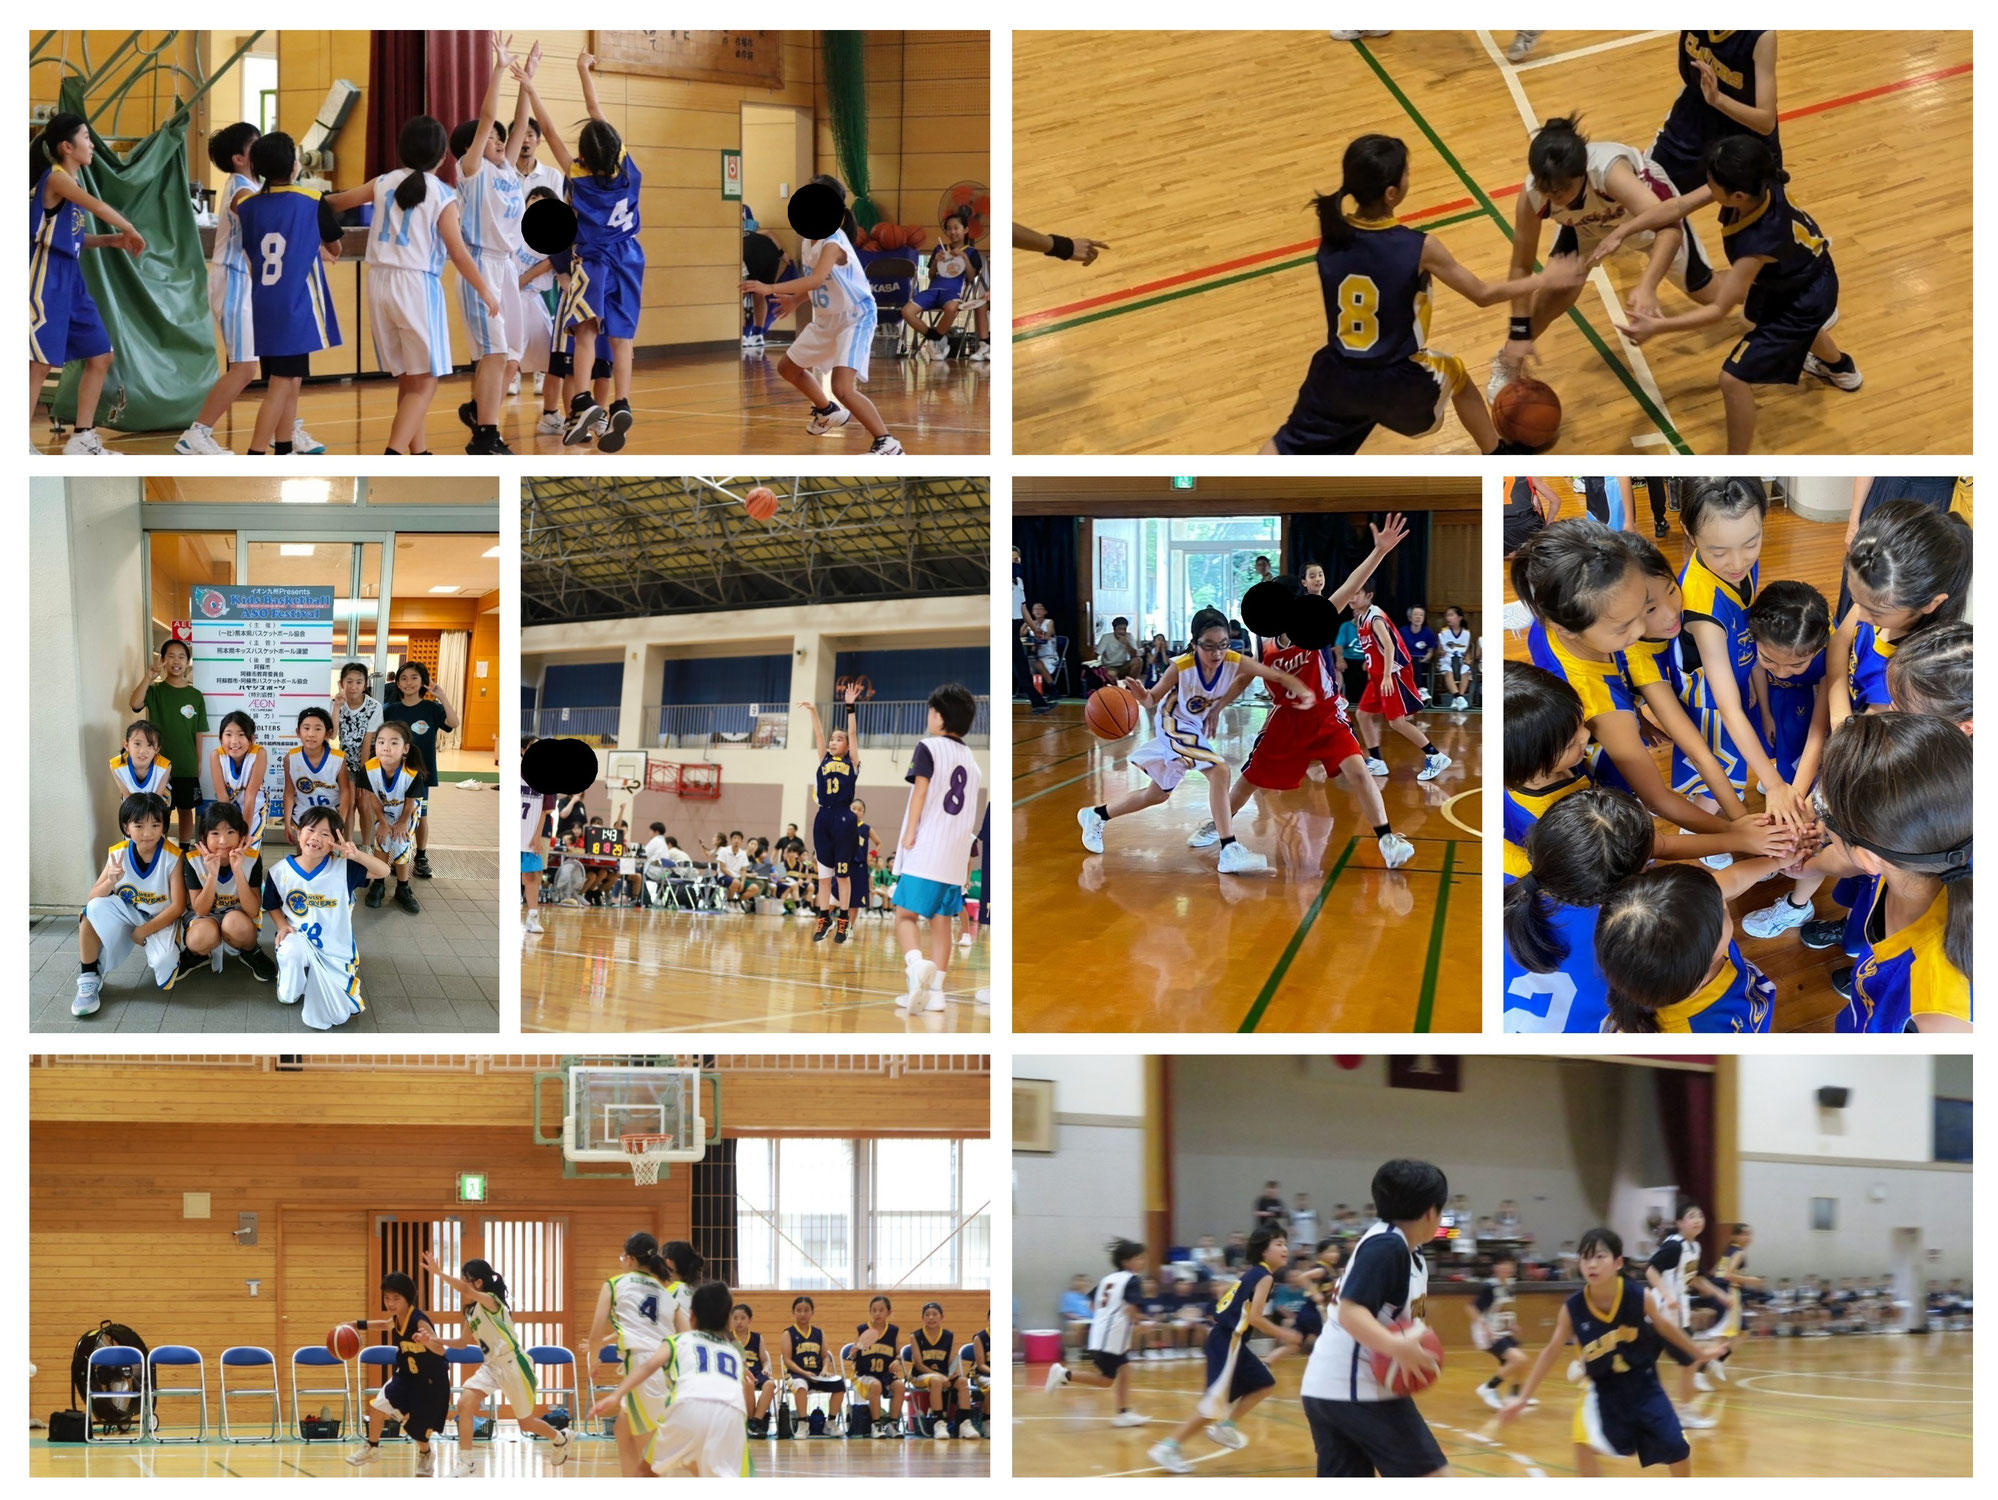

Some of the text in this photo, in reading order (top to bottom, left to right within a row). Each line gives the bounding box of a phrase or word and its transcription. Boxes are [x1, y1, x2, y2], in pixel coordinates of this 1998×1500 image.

[607, 198, 634, 232] 4
[260, 232, 287, 286] 8
[1337, 274, 1379, 351] 8
[1731, 340, 1750, 364] 1
[231, 595, 331, 605] Kids Basketball
[241, 608, 320, 619] ASO Festival
[827, 777, 839, 794] 13
[943, 765, 968, 815] 8
[522, 802, 531, 820] 7
[602, 829, 617, 842] 1:43
[837, 862, 848, 873] 13
[639, 1294, 659, 1325] 4
[694, 1344, 738, 1380] 10
[870, 1358, 884, 1372] 10
